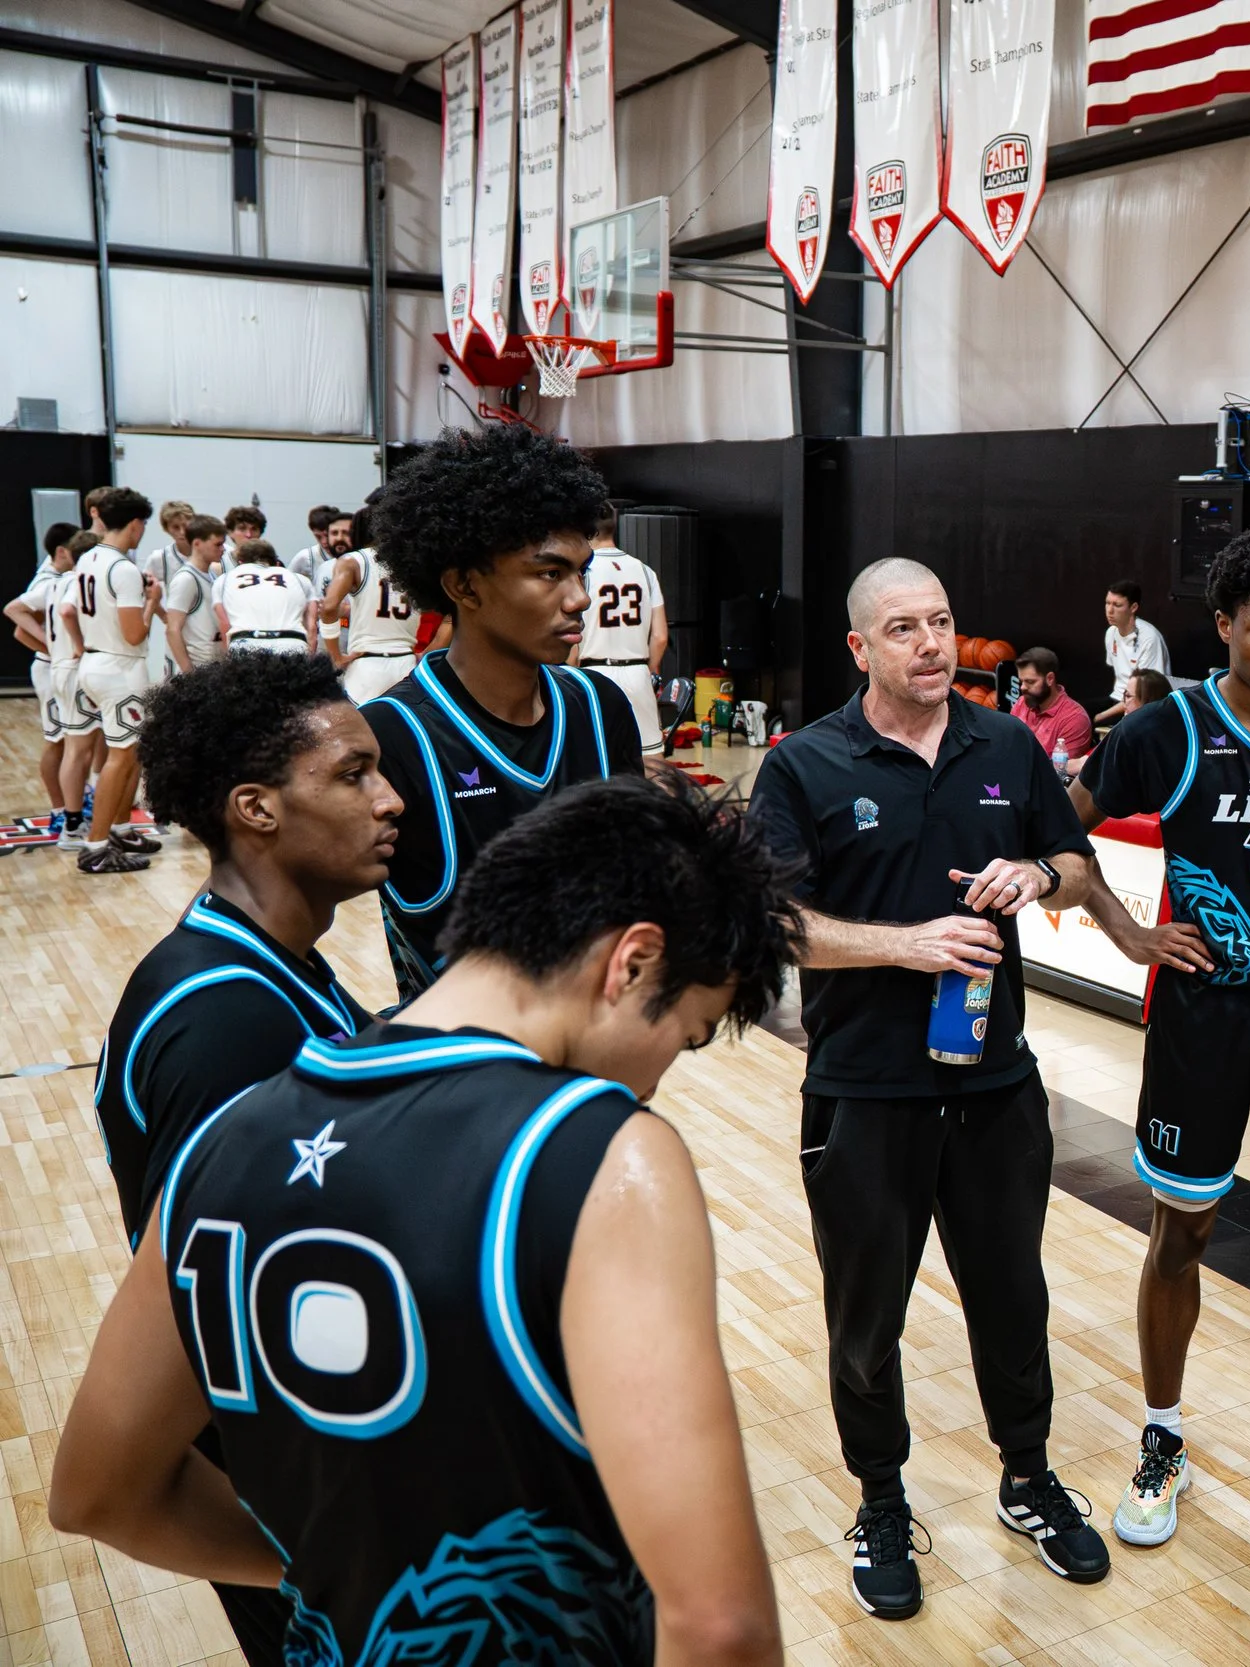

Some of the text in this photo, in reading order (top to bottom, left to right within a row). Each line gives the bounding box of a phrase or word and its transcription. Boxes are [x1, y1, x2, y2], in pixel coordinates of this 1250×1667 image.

[986, 142, 1026, 173] FAITH
[868, 168, 904, 196] FAITH
[985, 168, 1027, 189] ACADEMY
[236, 573, 288, 589] 34
[598, 583, 643, 628] 23
[454, 786, 497, 799] MONARCH
[1149, 1118, 1181, 1157] 11
[176, 1218, 428, 1440] 10
